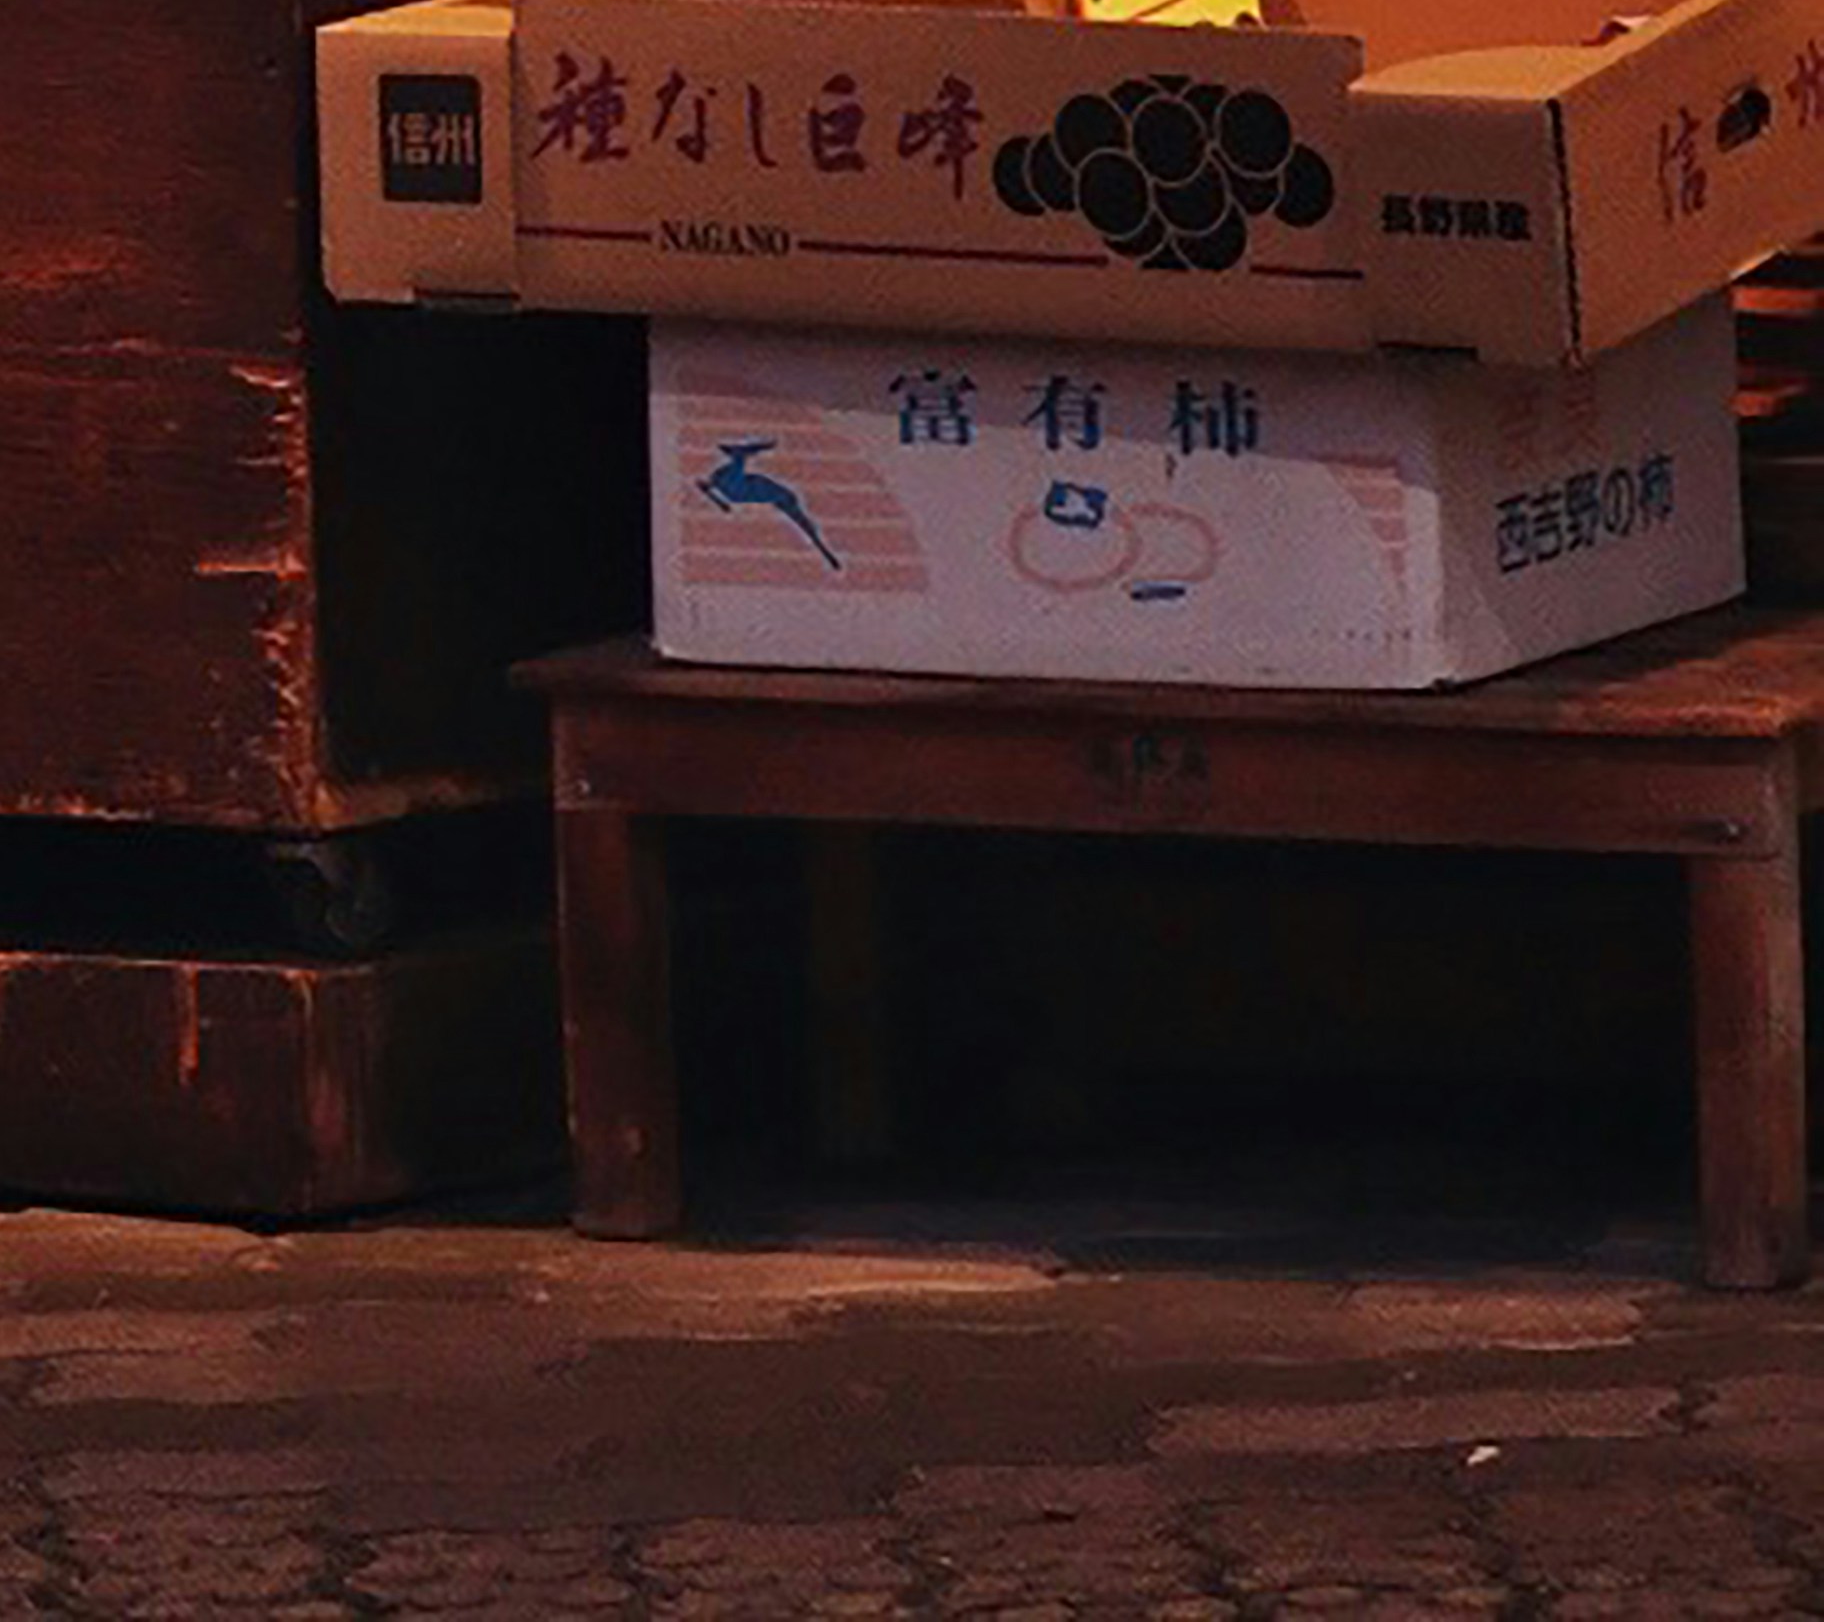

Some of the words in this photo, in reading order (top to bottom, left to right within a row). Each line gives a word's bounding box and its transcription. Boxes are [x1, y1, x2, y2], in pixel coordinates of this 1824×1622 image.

[387, 110, 477, 167] 信州
[531, 51, 984, 202] 種なし巨峰
[659, 219, 793, 259] NAGANO
